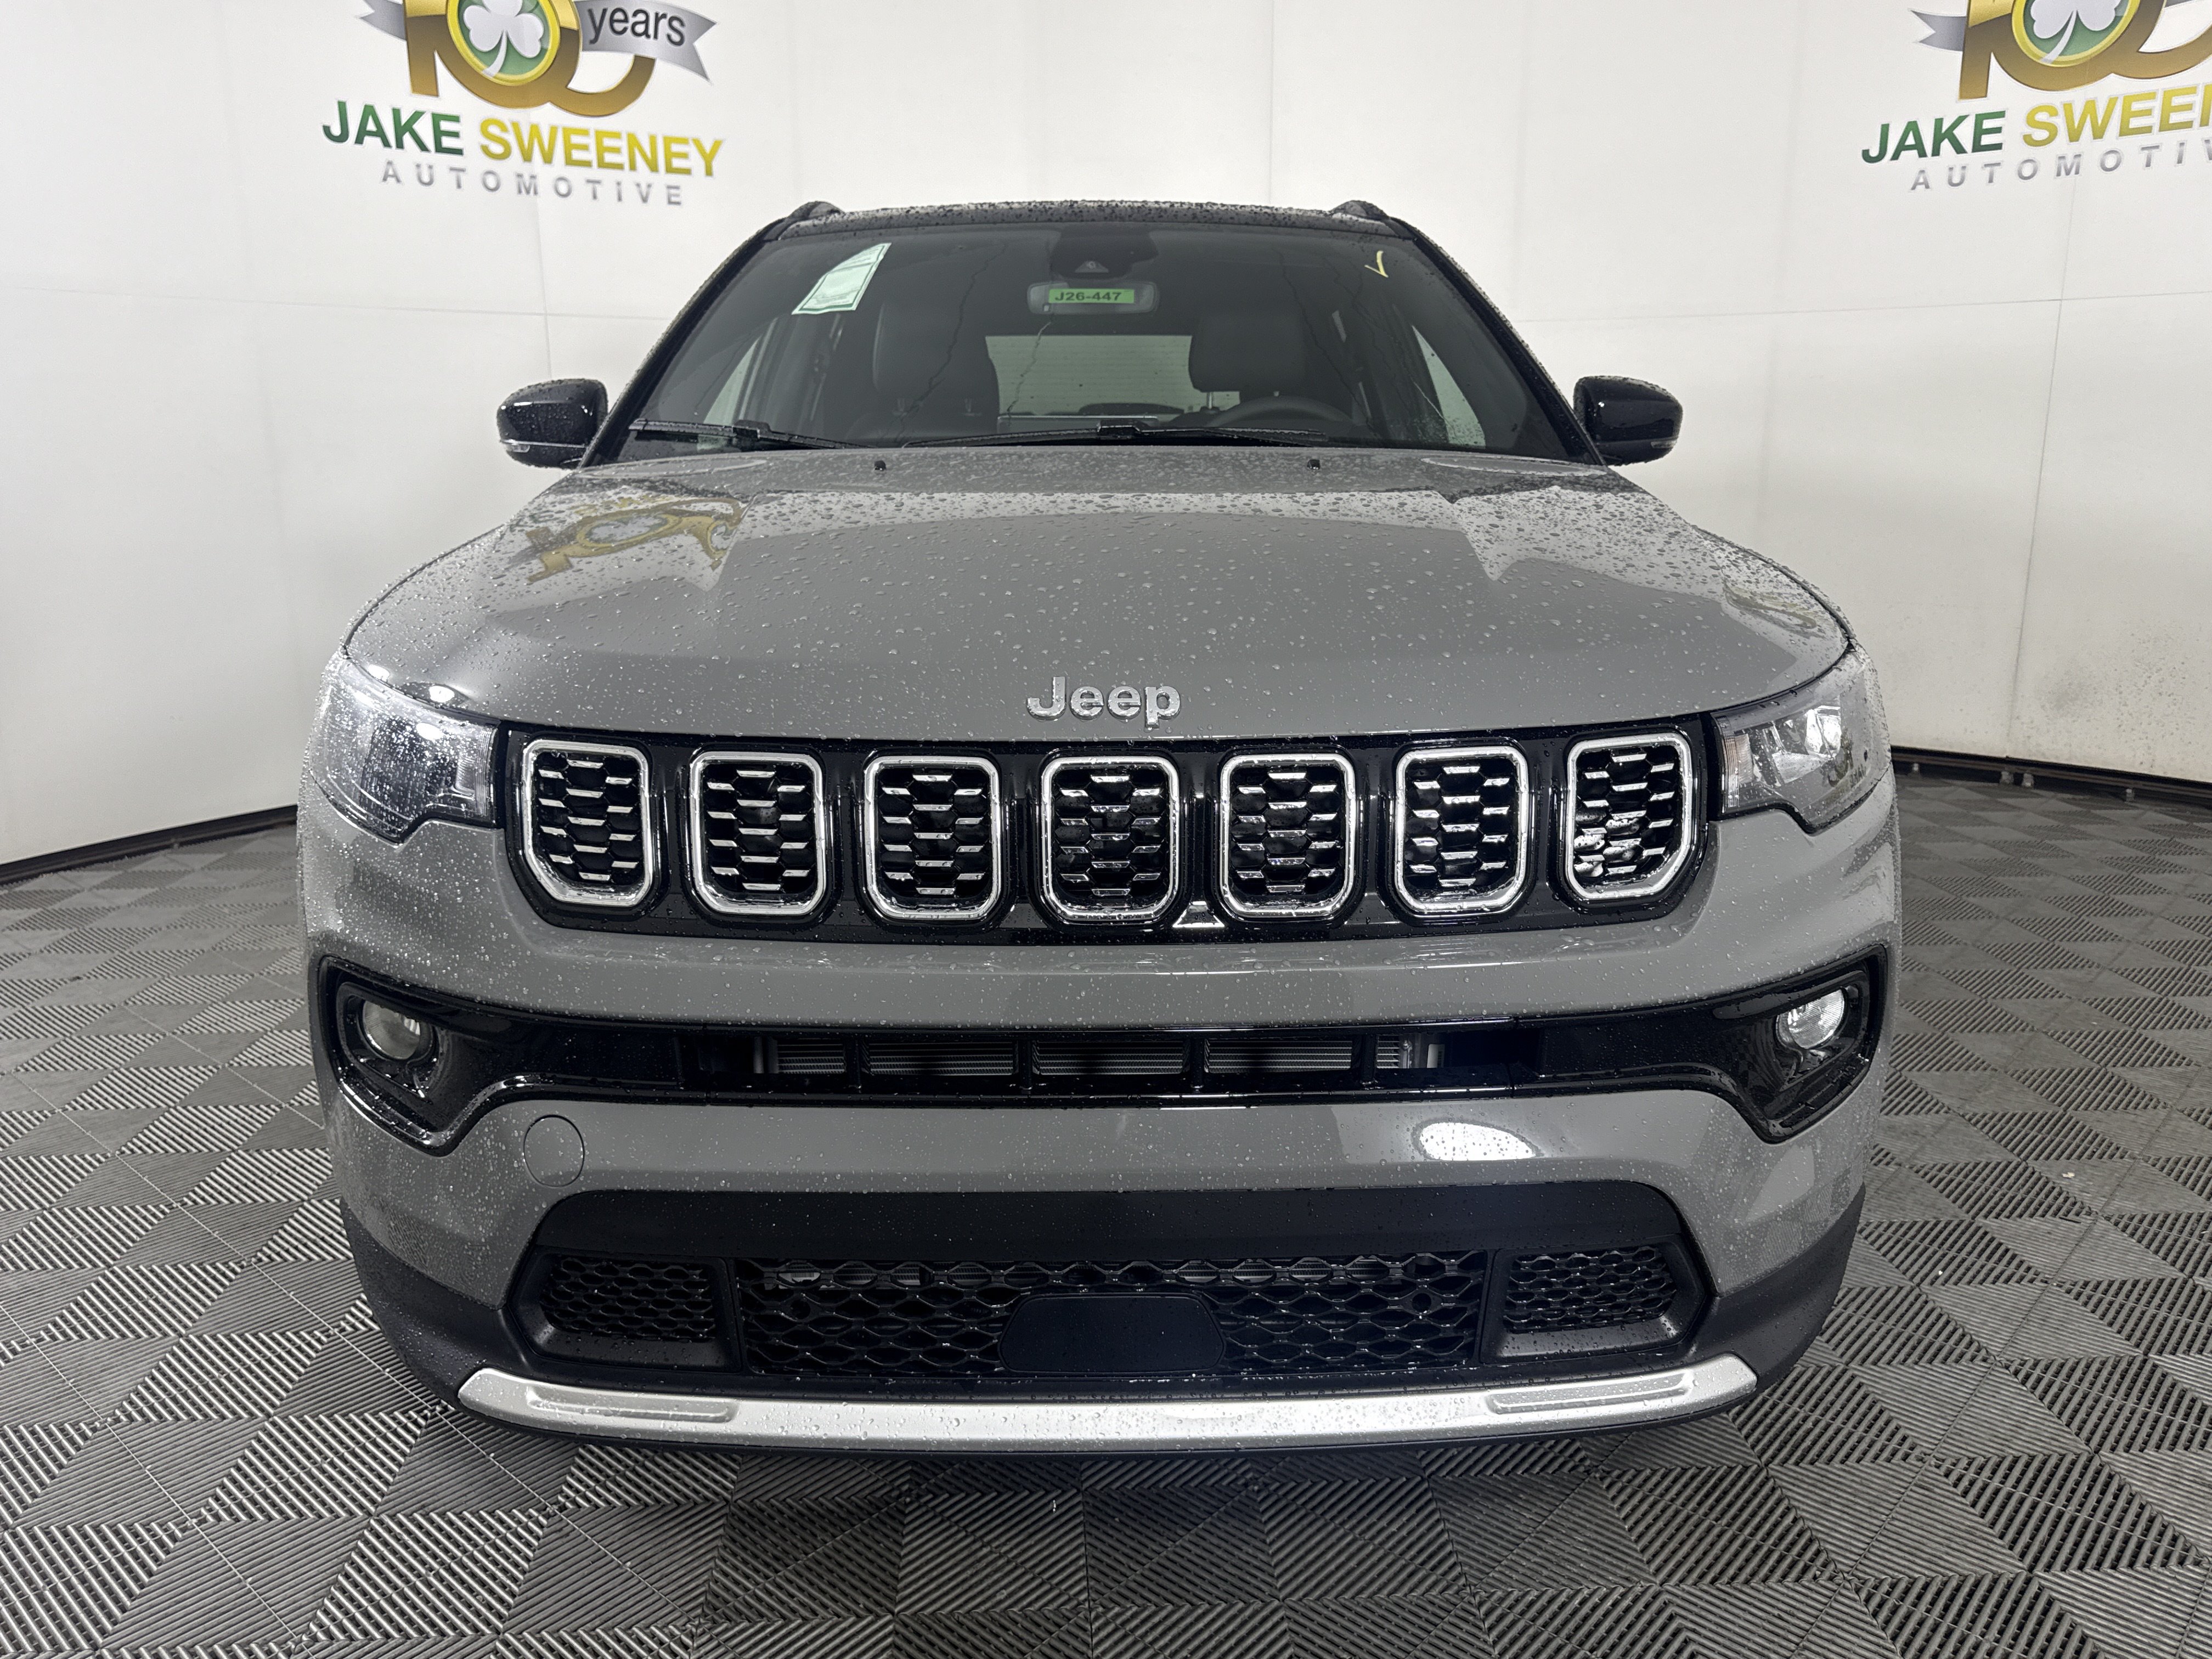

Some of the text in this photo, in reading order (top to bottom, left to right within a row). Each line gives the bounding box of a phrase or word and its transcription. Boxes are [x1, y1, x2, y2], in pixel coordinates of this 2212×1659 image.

[588, 7, 686, 46] years
[322, 101, 724, 176] JAKE SWEENEY
[1861, 110, 2006, 163] JAKE
[382, 160, 683, 205] AUTOMOTIVE
[1055, 292, 1121, 301] J26-447
[1027, 676, 1181, 729] Jeep
